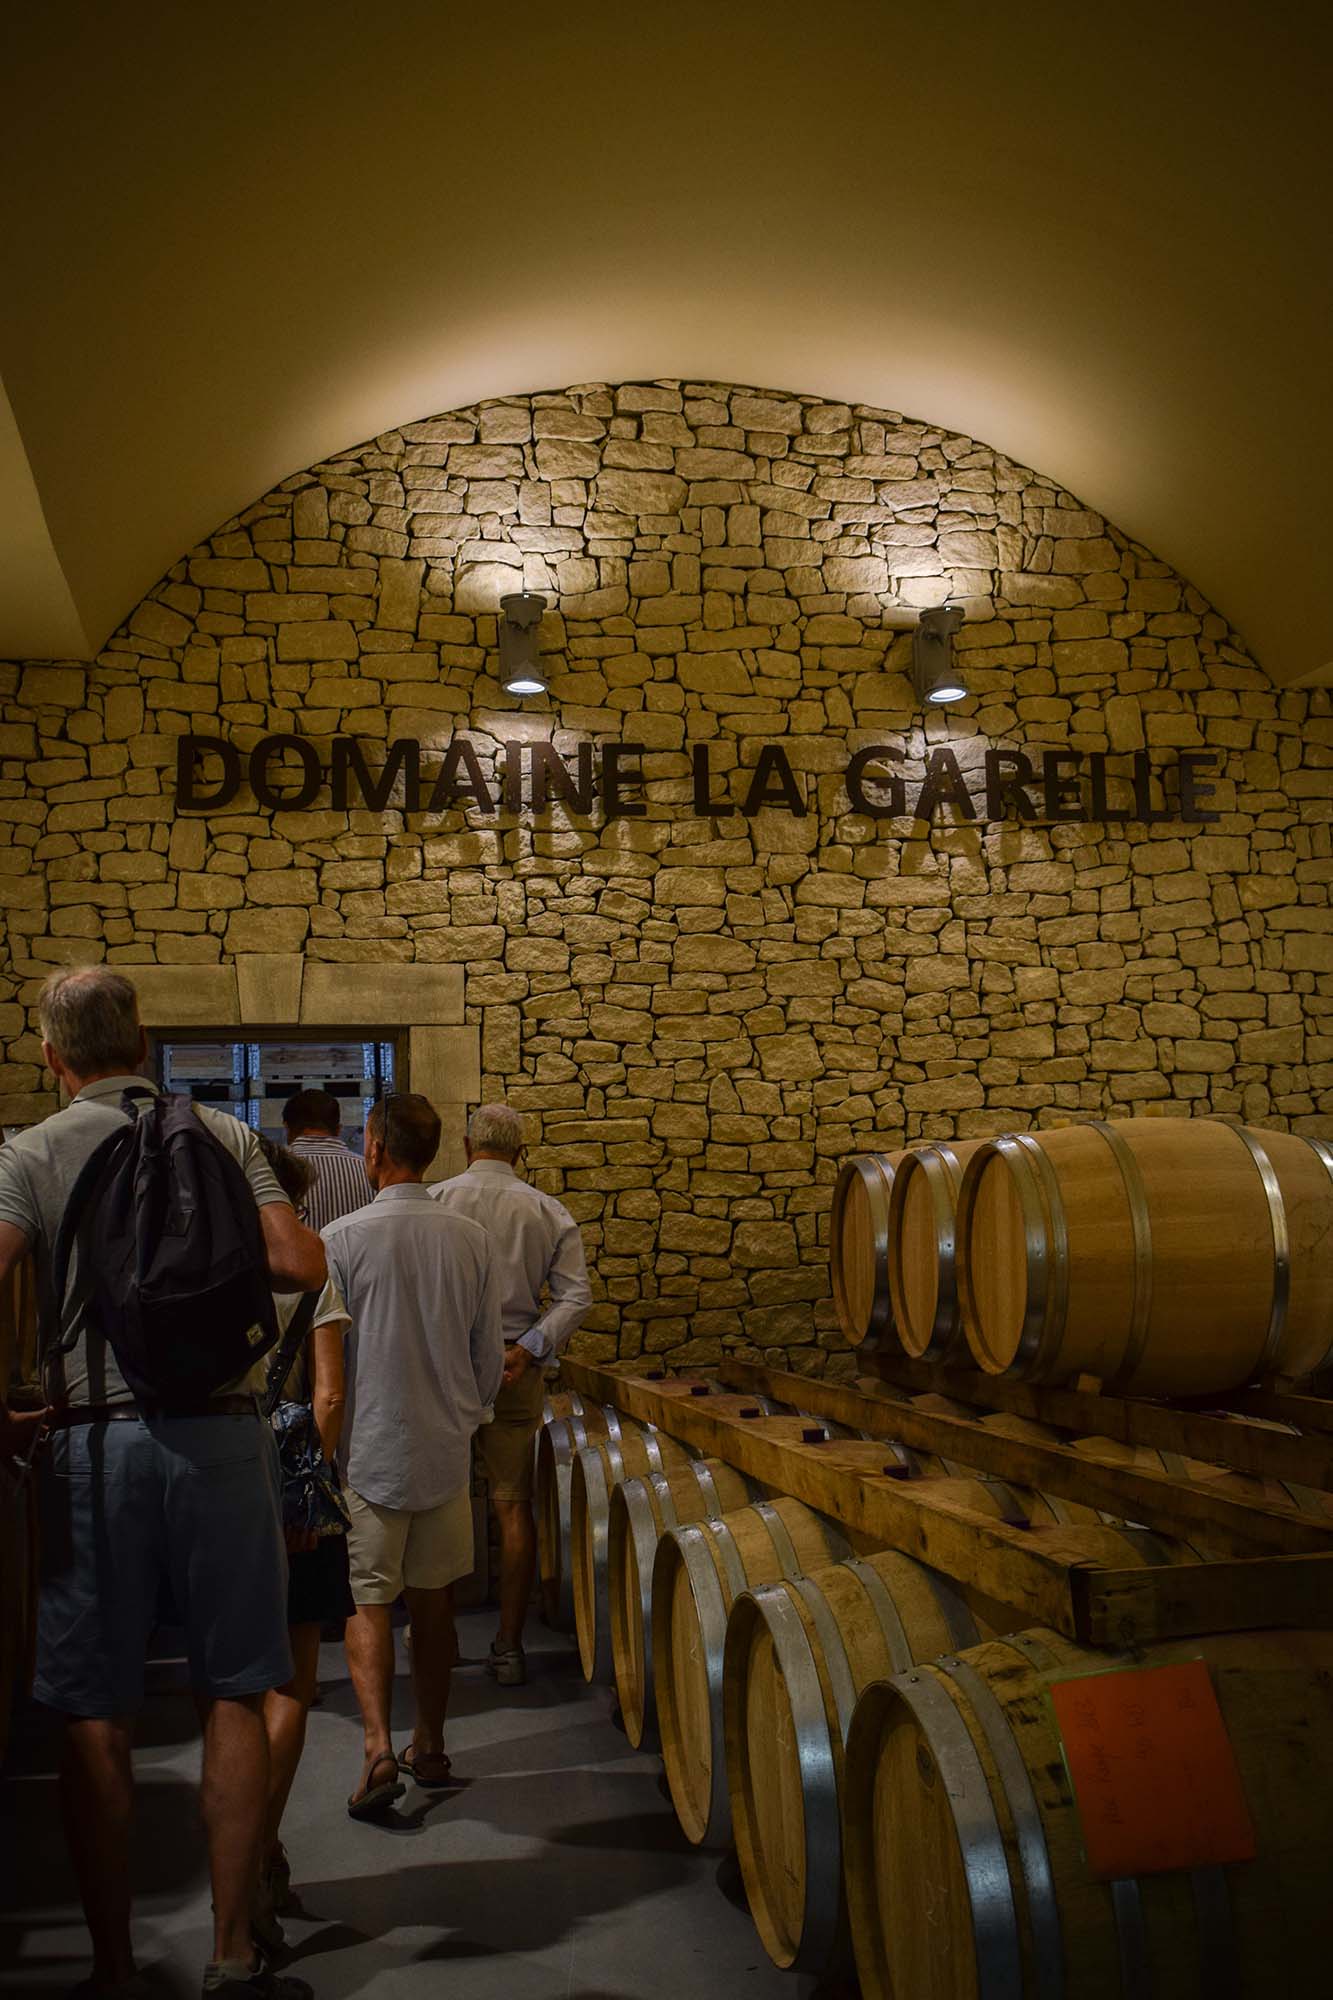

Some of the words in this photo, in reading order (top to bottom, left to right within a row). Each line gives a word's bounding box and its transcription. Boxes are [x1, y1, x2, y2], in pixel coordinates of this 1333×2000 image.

[176, 735, 646, 816] DOMAINE
[692, 743, 807, 817] LA
[846, 745, 1220, 823] GARELLE
